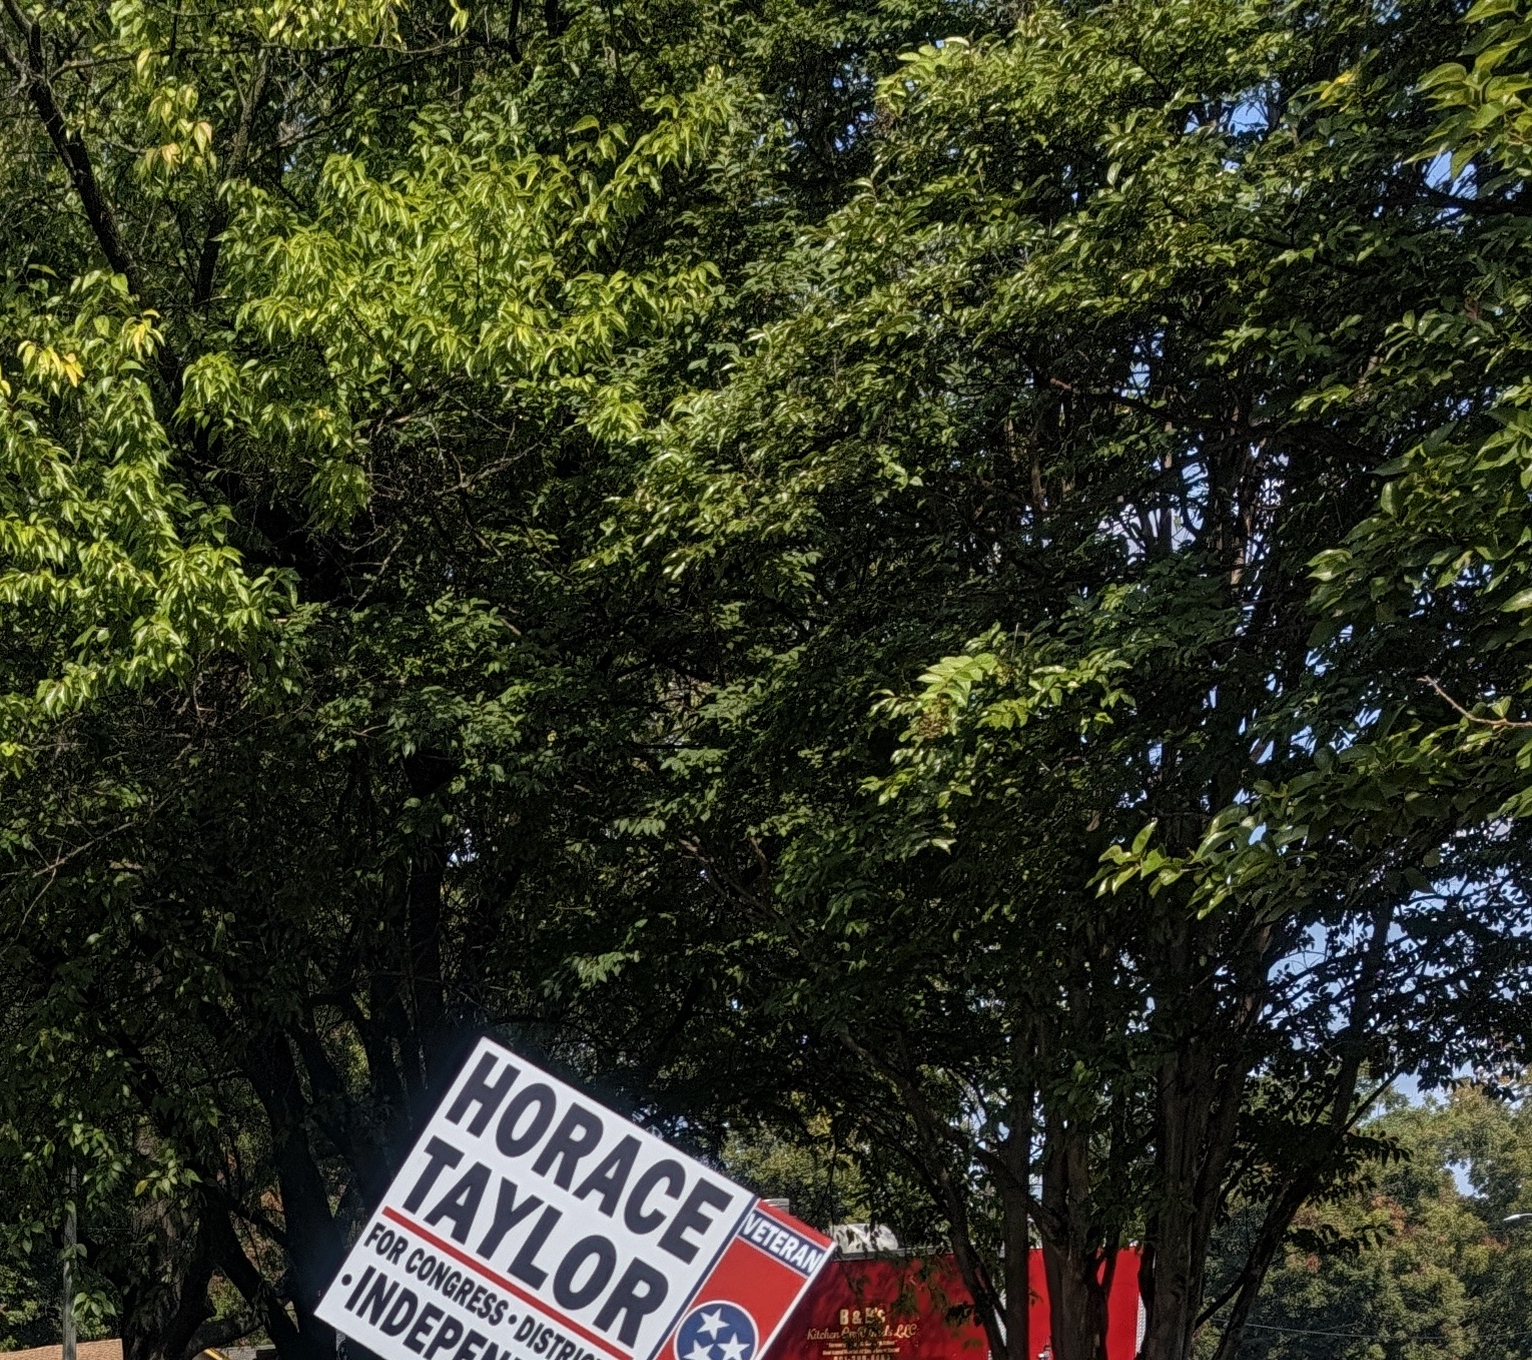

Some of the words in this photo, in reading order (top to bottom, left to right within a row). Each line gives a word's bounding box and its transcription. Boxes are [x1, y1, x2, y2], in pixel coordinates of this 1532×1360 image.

[446, 1052, 734, 1265] HORACE
[364, 1222, 408, 1263] FOR
[405, 1248, 509, 1328] CONGRESS
[402, 1135, 668, 1347] TAYLOR
[742, 1213, 826, 1273] VETERAN
